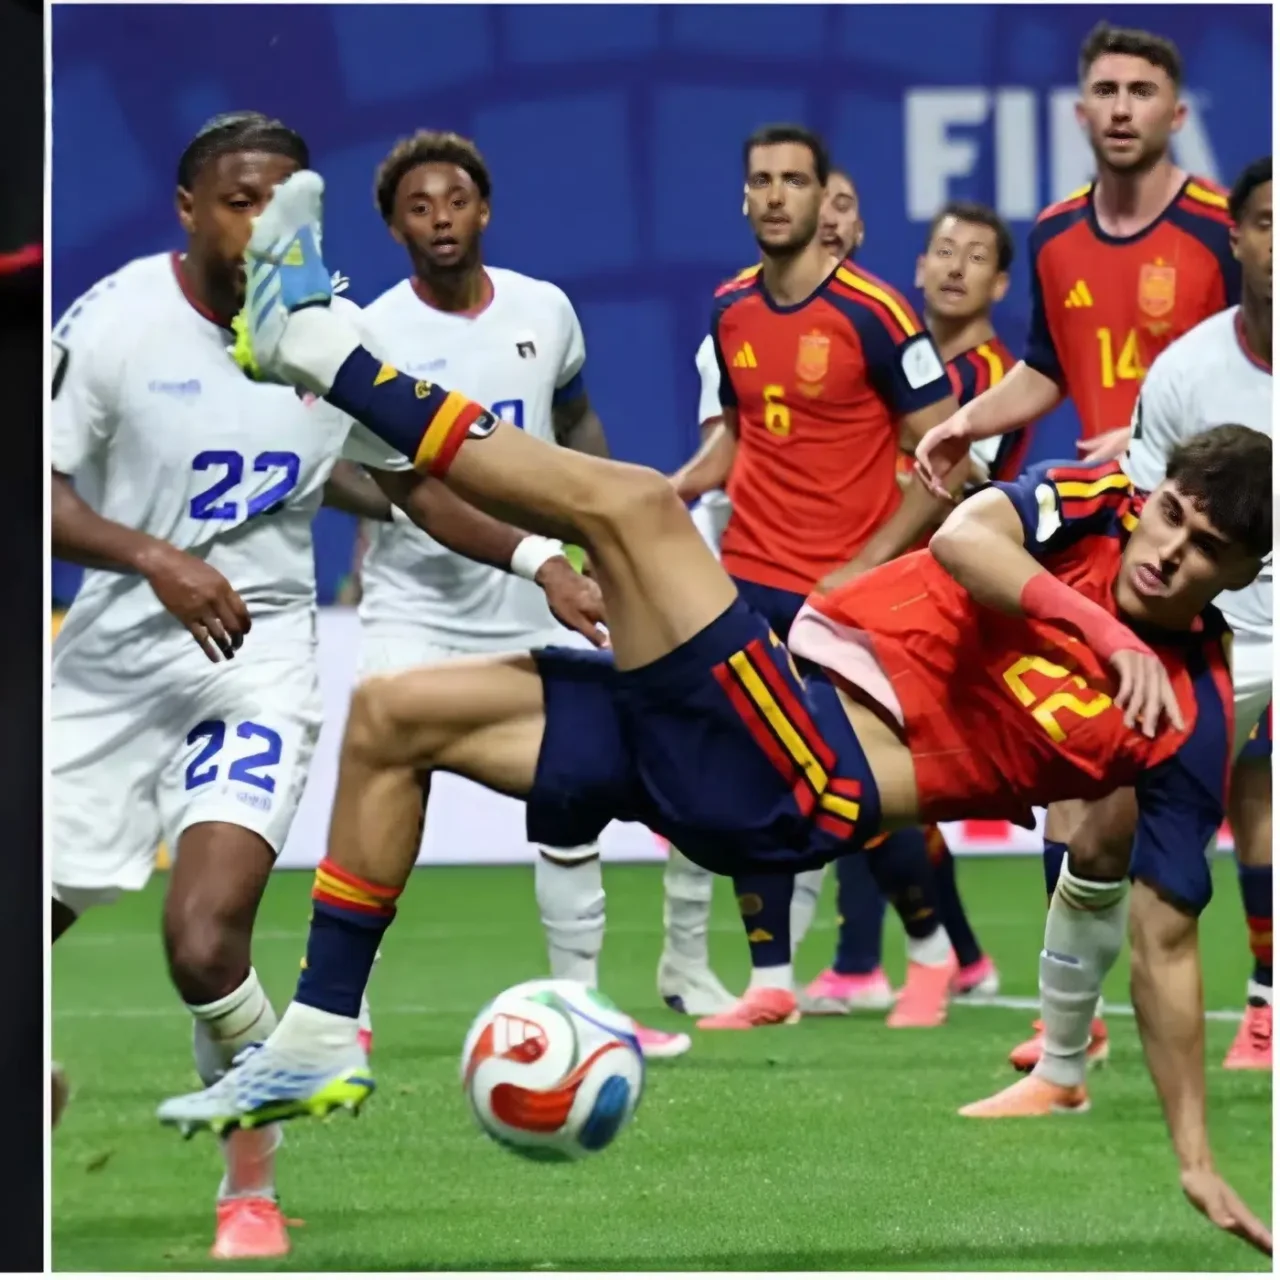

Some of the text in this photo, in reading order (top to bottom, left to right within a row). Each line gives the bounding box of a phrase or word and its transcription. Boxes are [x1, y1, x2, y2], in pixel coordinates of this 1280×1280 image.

[906, 88, 1223, 222] FI
[1096, 327, 1148, 389] 14
[763, 384, 791, 436] 6
[190, 450, 301, 520] 22
[185, 718, 282, 793] 22
